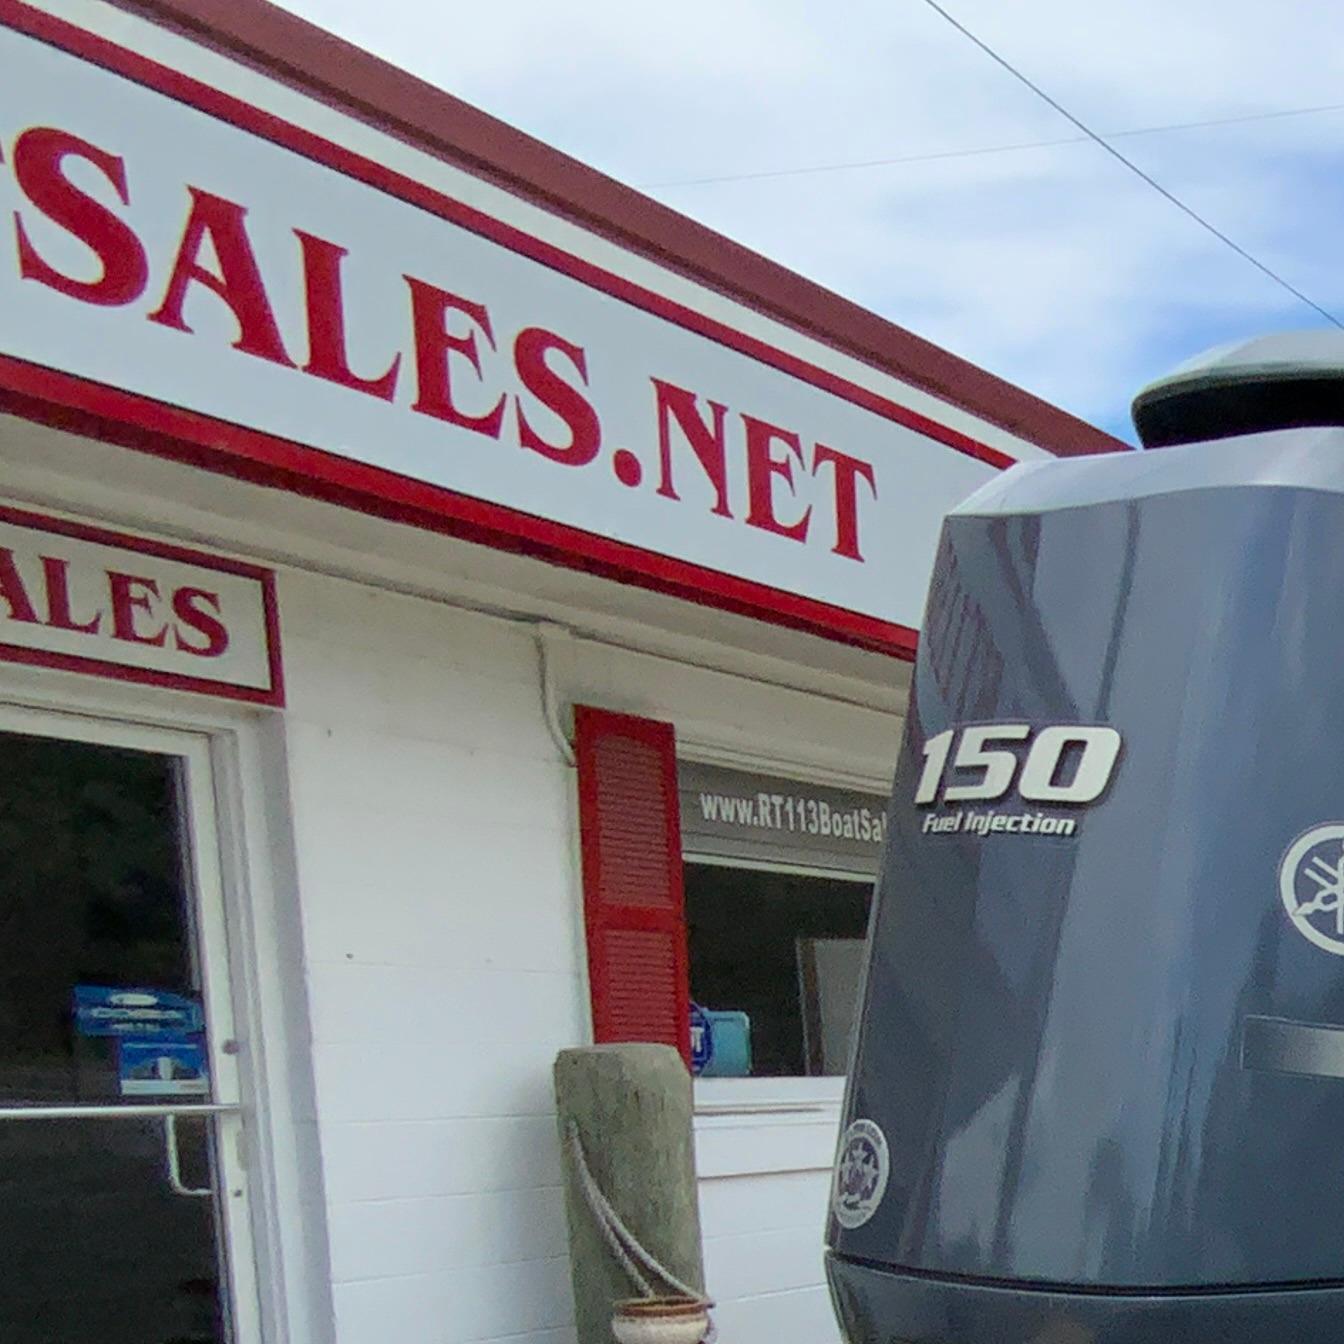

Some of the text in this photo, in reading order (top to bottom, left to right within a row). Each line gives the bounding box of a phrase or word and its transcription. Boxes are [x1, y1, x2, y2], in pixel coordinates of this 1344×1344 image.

[0, 127, 877, 563] SALES.NET
[914, 725, 1121, 804] 150
[922, 810, 1076, 835] Fuel Injection
